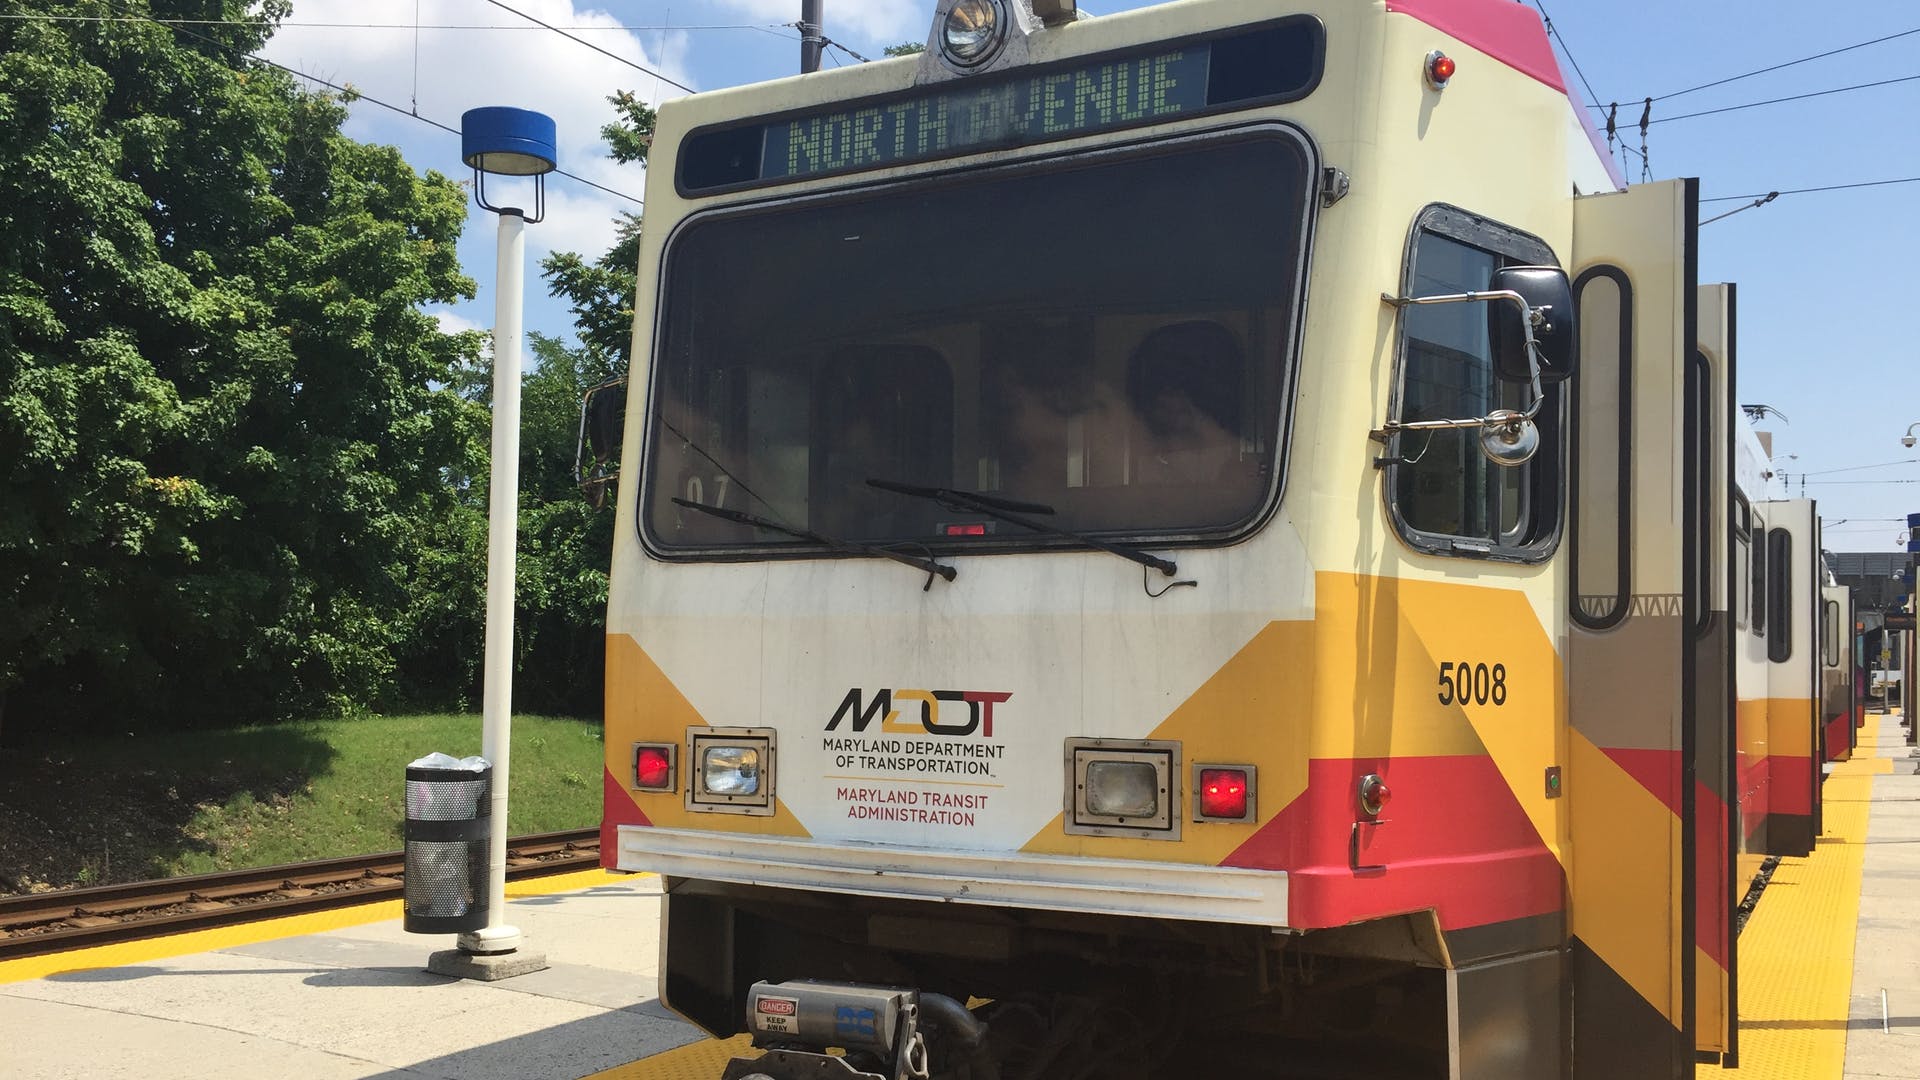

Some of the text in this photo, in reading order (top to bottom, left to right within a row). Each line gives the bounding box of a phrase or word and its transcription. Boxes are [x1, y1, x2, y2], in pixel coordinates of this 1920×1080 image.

[788, 50, 1183, 175] NORTH AVENUE
[1438, 661, 1507, 706] 5008
[824, 688, 1014, 737] MDOT
[823, 738, 1005, 759] MARYLAND DEPARTMENT
[835, 755, 990, 776] OF TRANSPORTATION
[837, 787, 988, 810] MARYLAND TRANSIT
[847, 806, 975, 827] ADMINISTRATION
[761, 1001, 793, 1013] DANGER
[766, 1016, 786, 1024] KEEP
[767, 1024, 788, 1032] AWAY
